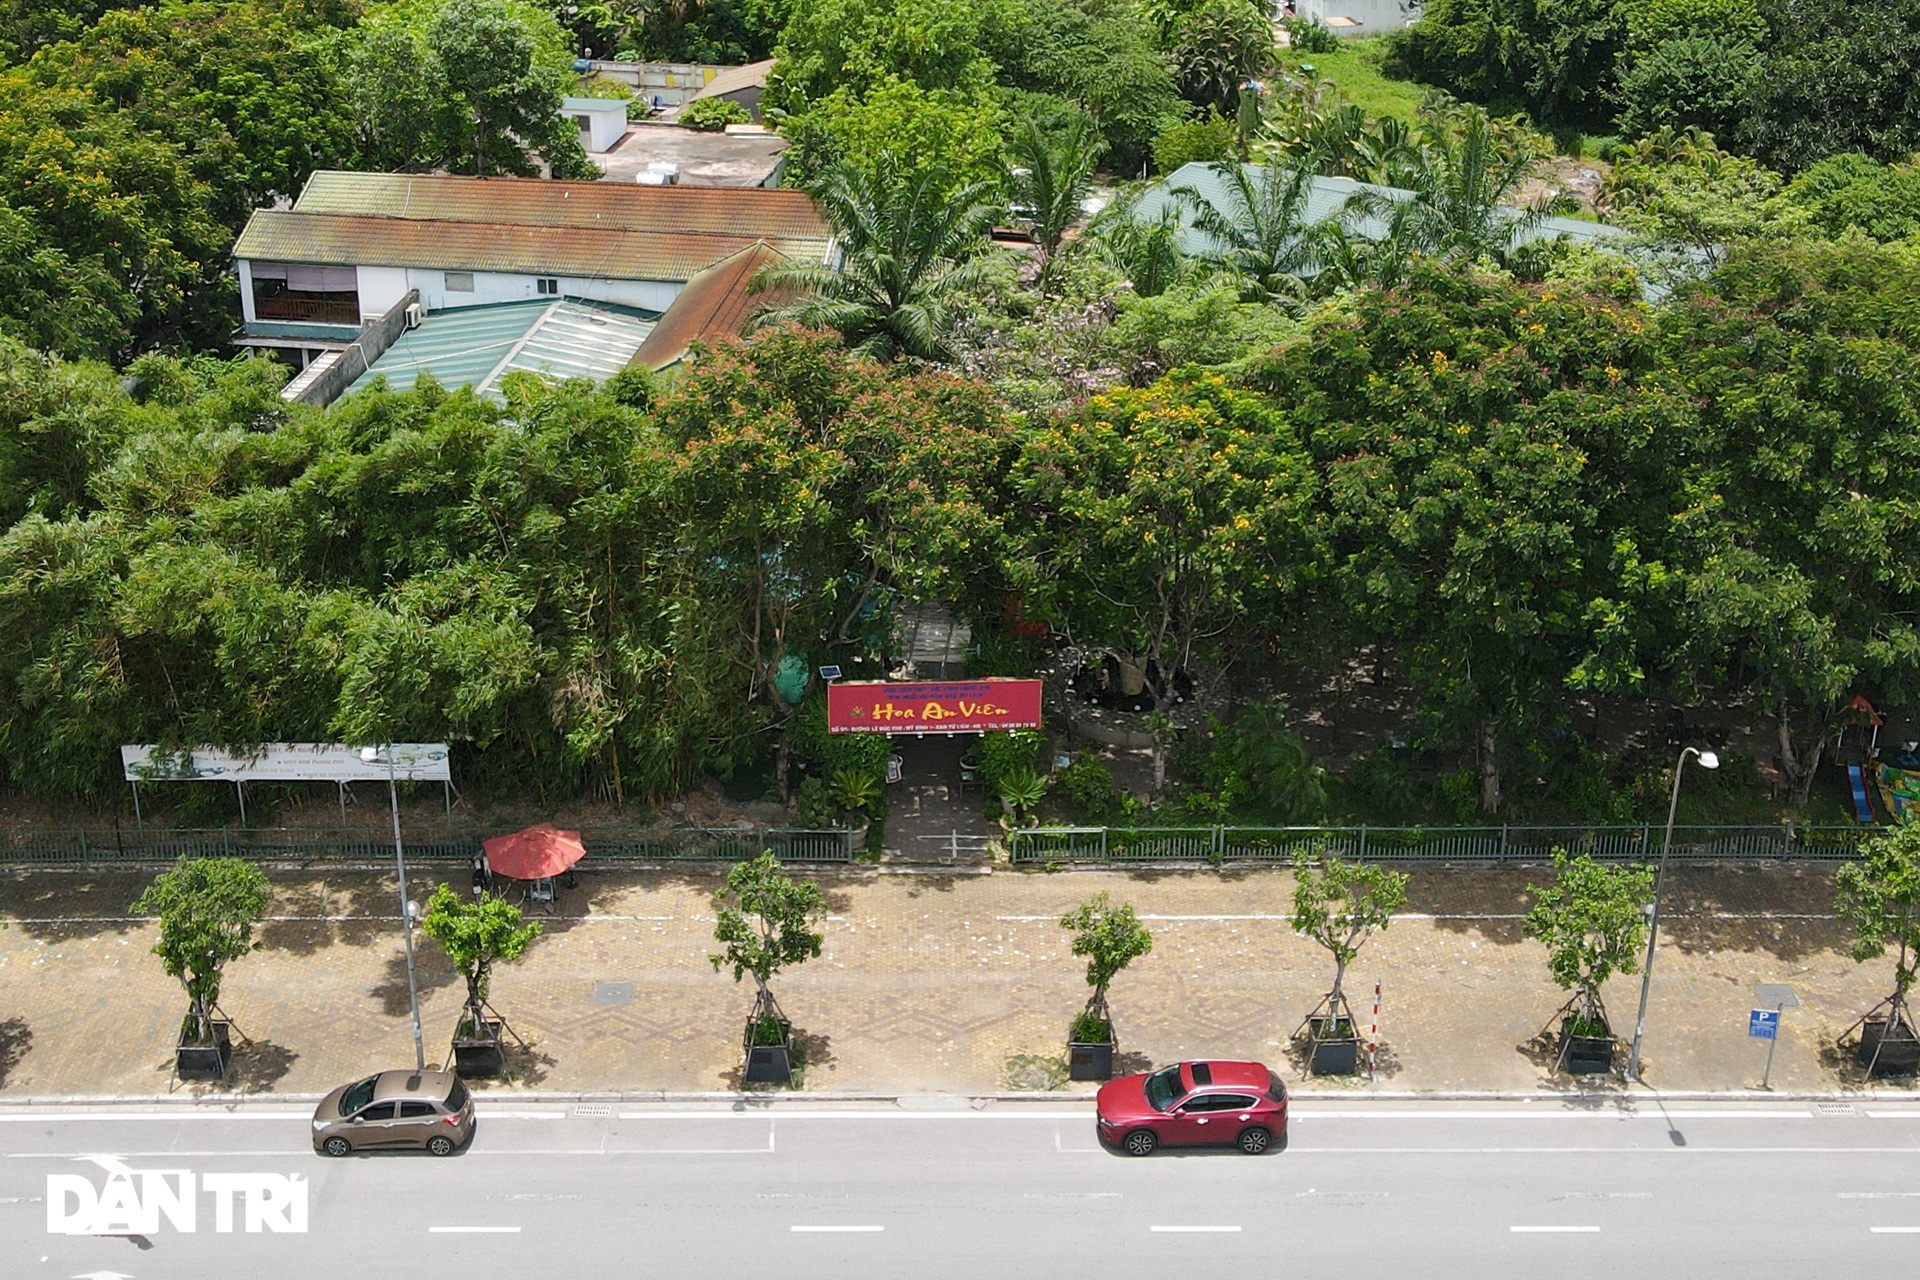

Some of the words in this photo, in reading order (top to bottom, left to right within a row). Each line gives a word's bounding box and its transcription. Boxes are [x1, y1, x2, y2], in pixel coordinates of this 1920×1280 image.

[872, 703, 915, 721] Hoa
[921, 702, 958, 721] An
[958, 701, 1009, 718] Viên
[1760, 1012, 1769, 1022] P
